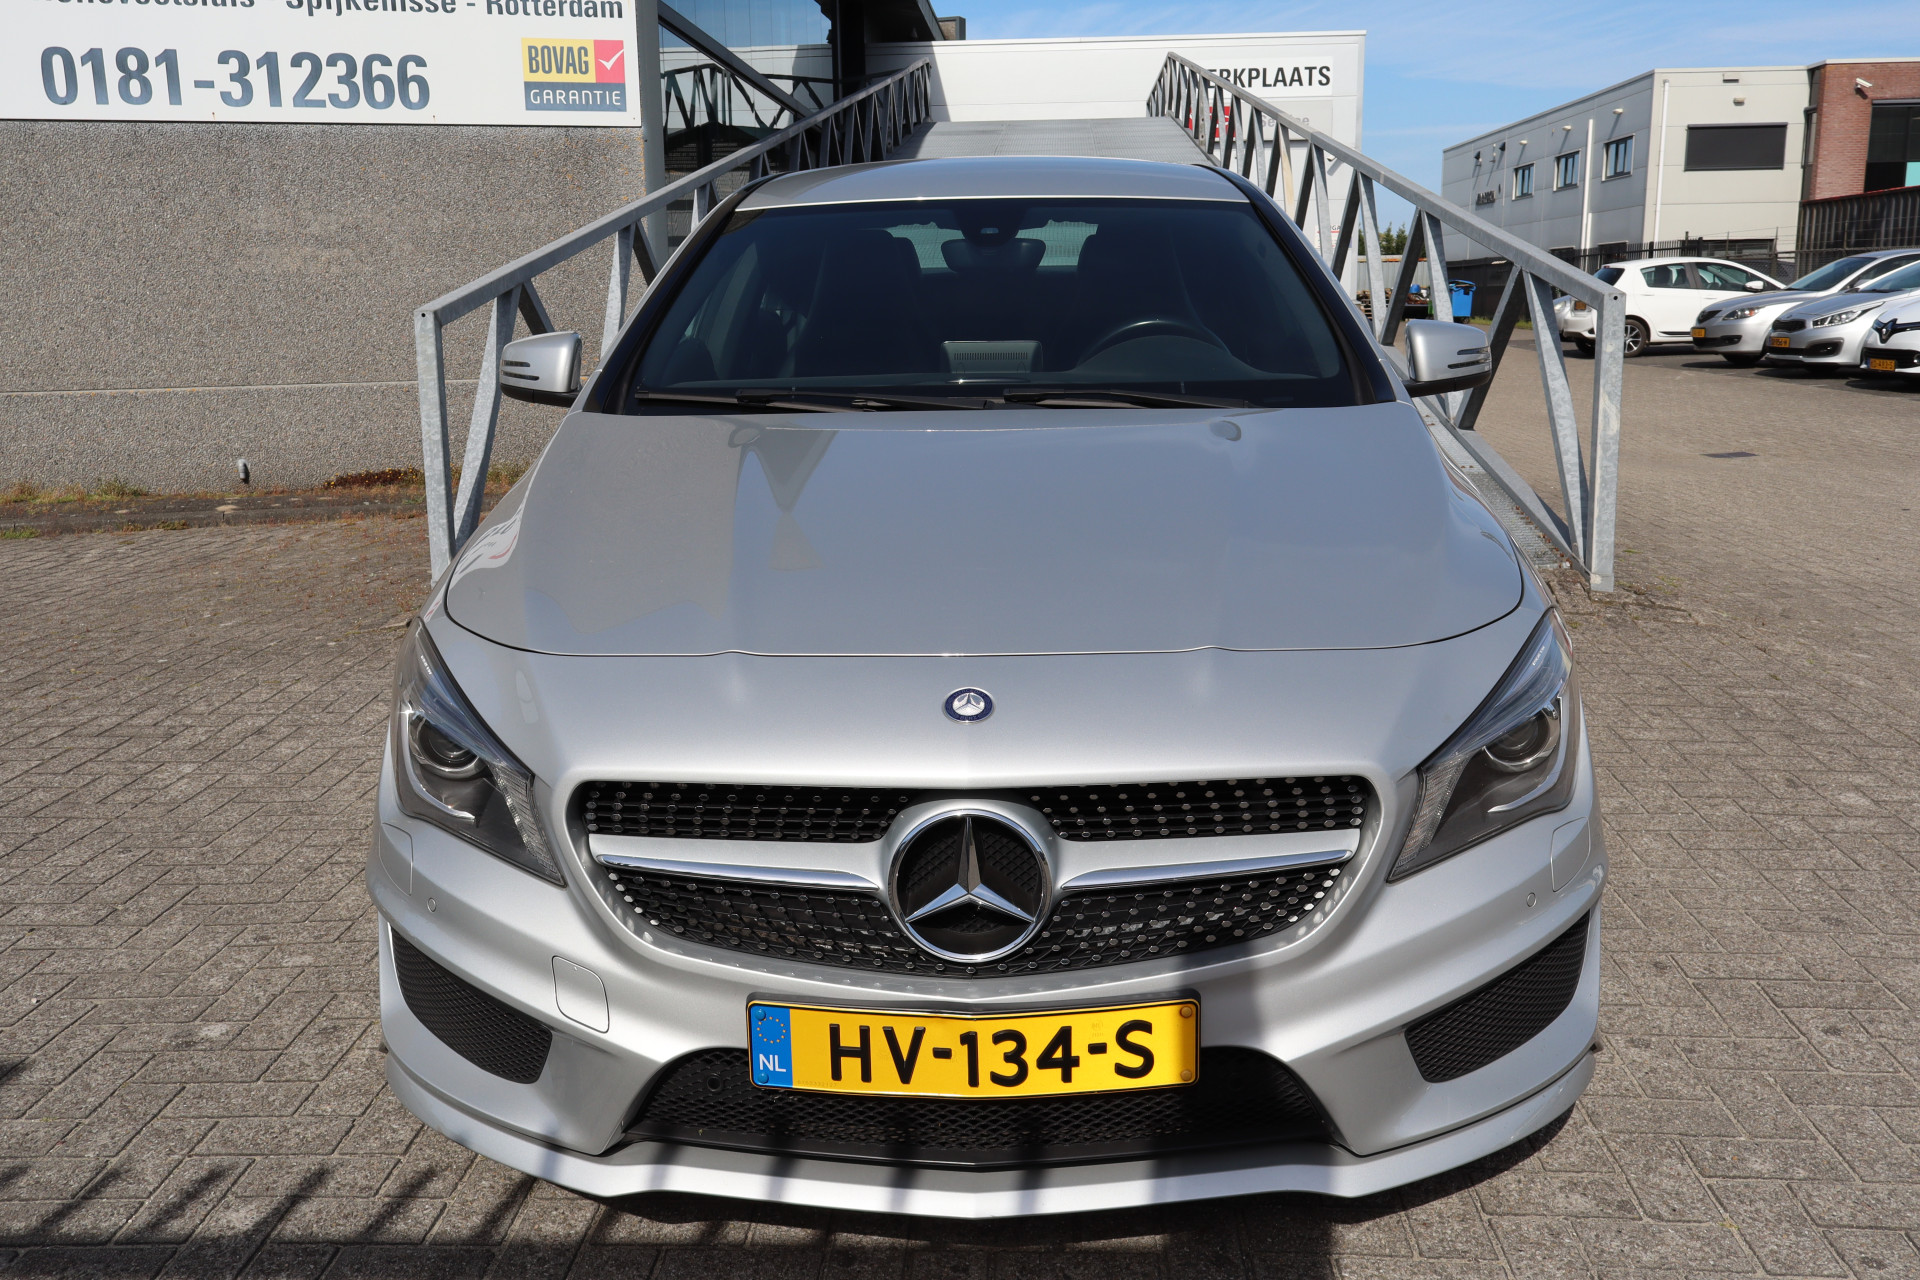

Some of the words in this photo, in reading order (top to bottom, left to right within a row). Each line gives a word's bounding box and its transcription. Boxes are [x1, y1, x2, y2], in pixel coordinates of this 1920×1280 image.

[485, 0, 624, 19] Rotterdam
[527, 45, 589, 75] BOVAG
[40, 46, 430, 111] 0181-312366
[530, 89, 621, 106] GARANTIE
[759, 1053, 787, 1073] NL
[828, 1019, 1155, 1088] HV-134-S
